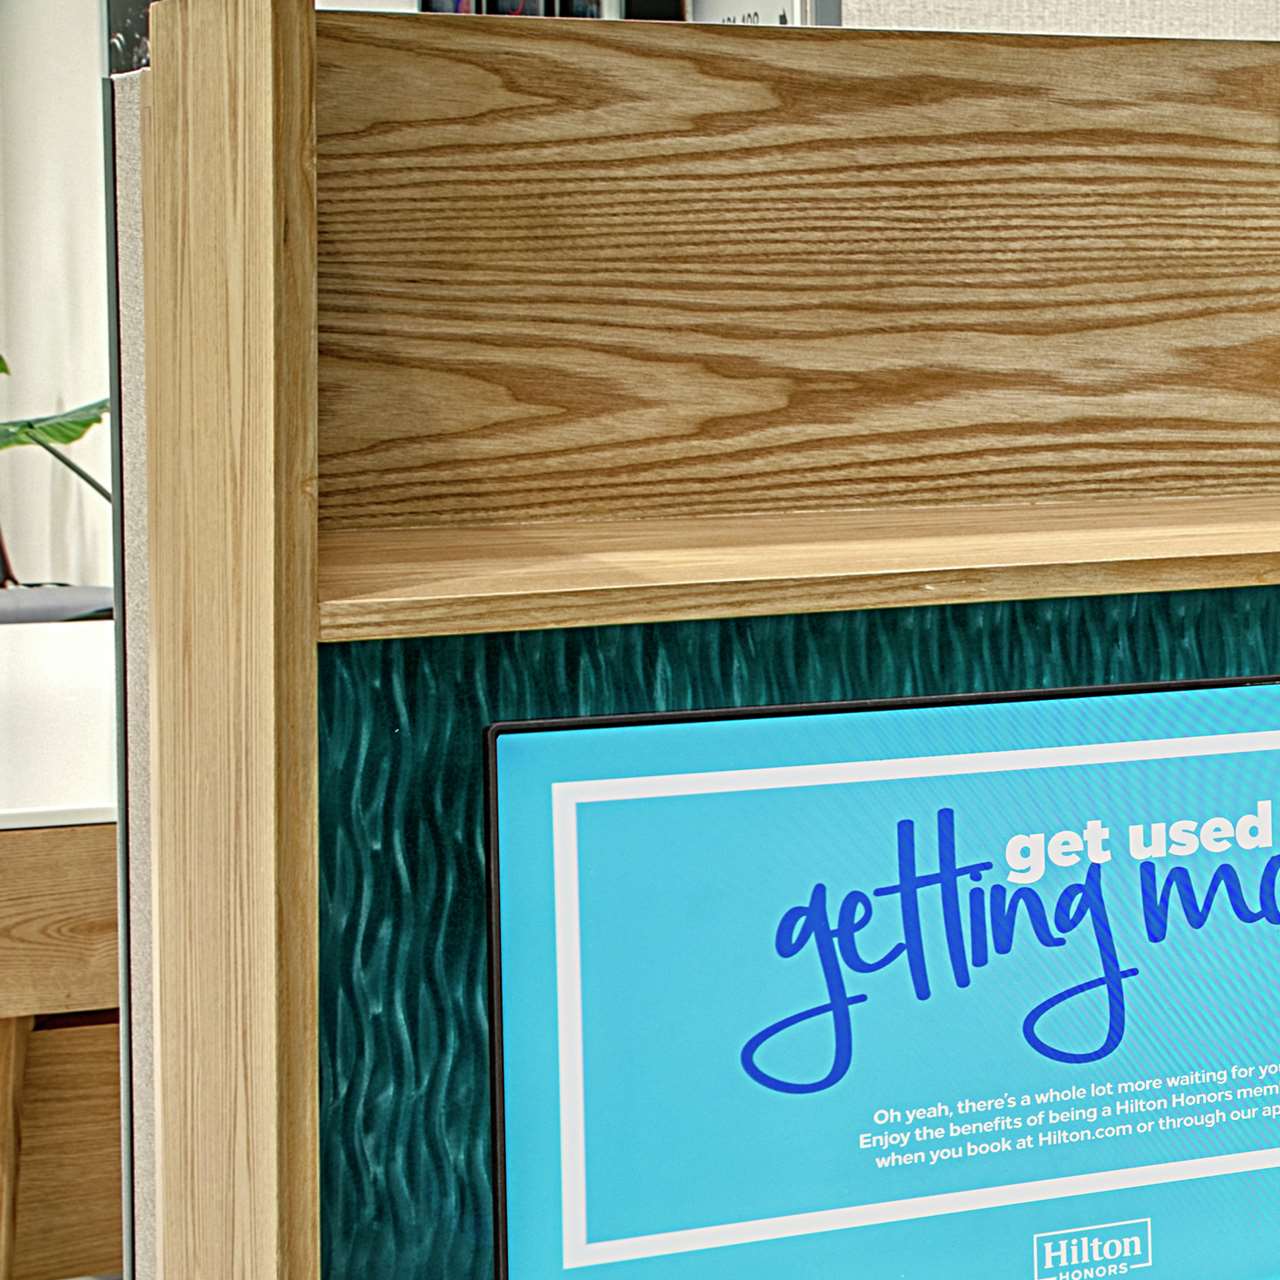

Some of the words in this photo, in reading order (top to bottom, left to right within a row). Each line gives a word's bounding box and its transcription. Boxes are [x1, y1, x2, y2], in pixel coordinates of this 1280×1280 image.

[1004, 818, 1112, 884] get
[1127, 800, 1274, 861] used
[740, 807, 1141, 1095] getting
[858, 1132, 911, 1150] Enjoy
[914, 1125, 946, 1142] the
[949, 1116, 1023, 1137] benefits
[1026, 1111, 1045, 1127] of
[1048, 1106, 1097, 1125] being
[1101, 1106, 1112, 1118] a
[1115, 1098, 1168, 1116] Hilton
[1171, 1089, 1233, 1109] Honors
[873, 1108, 901, 1125] Oh
[905, 1102, 953, 1124] yeah,
[957, 1092, 1017, 1114] there's
[1020, 1094, 1031, 1106] a
[1035, 1085, 1087, 1105] whole
[1090, 1082, 1114, 1097] lot
[1117, 1077, 1163, 1095] more
[1166, 1068, 1228, 1087] waiting
[1230, 1064, 1256, 1080] for
[874, 1151, 926, 1169] when
[929, 1146, 963, 1165] you
[966, 1138, 1012, 1157] book
[1015, 1135, 1034, 1150] at
[1038, 1124, 1133, 1147] Hilton.com
[1136, 1119, 1155, 1134] or
[1157, 1109, 1227, 1131] through
[1229, 1106, 1259, 1122] our
[1043, 1236, 1143, 1269] Hilton
